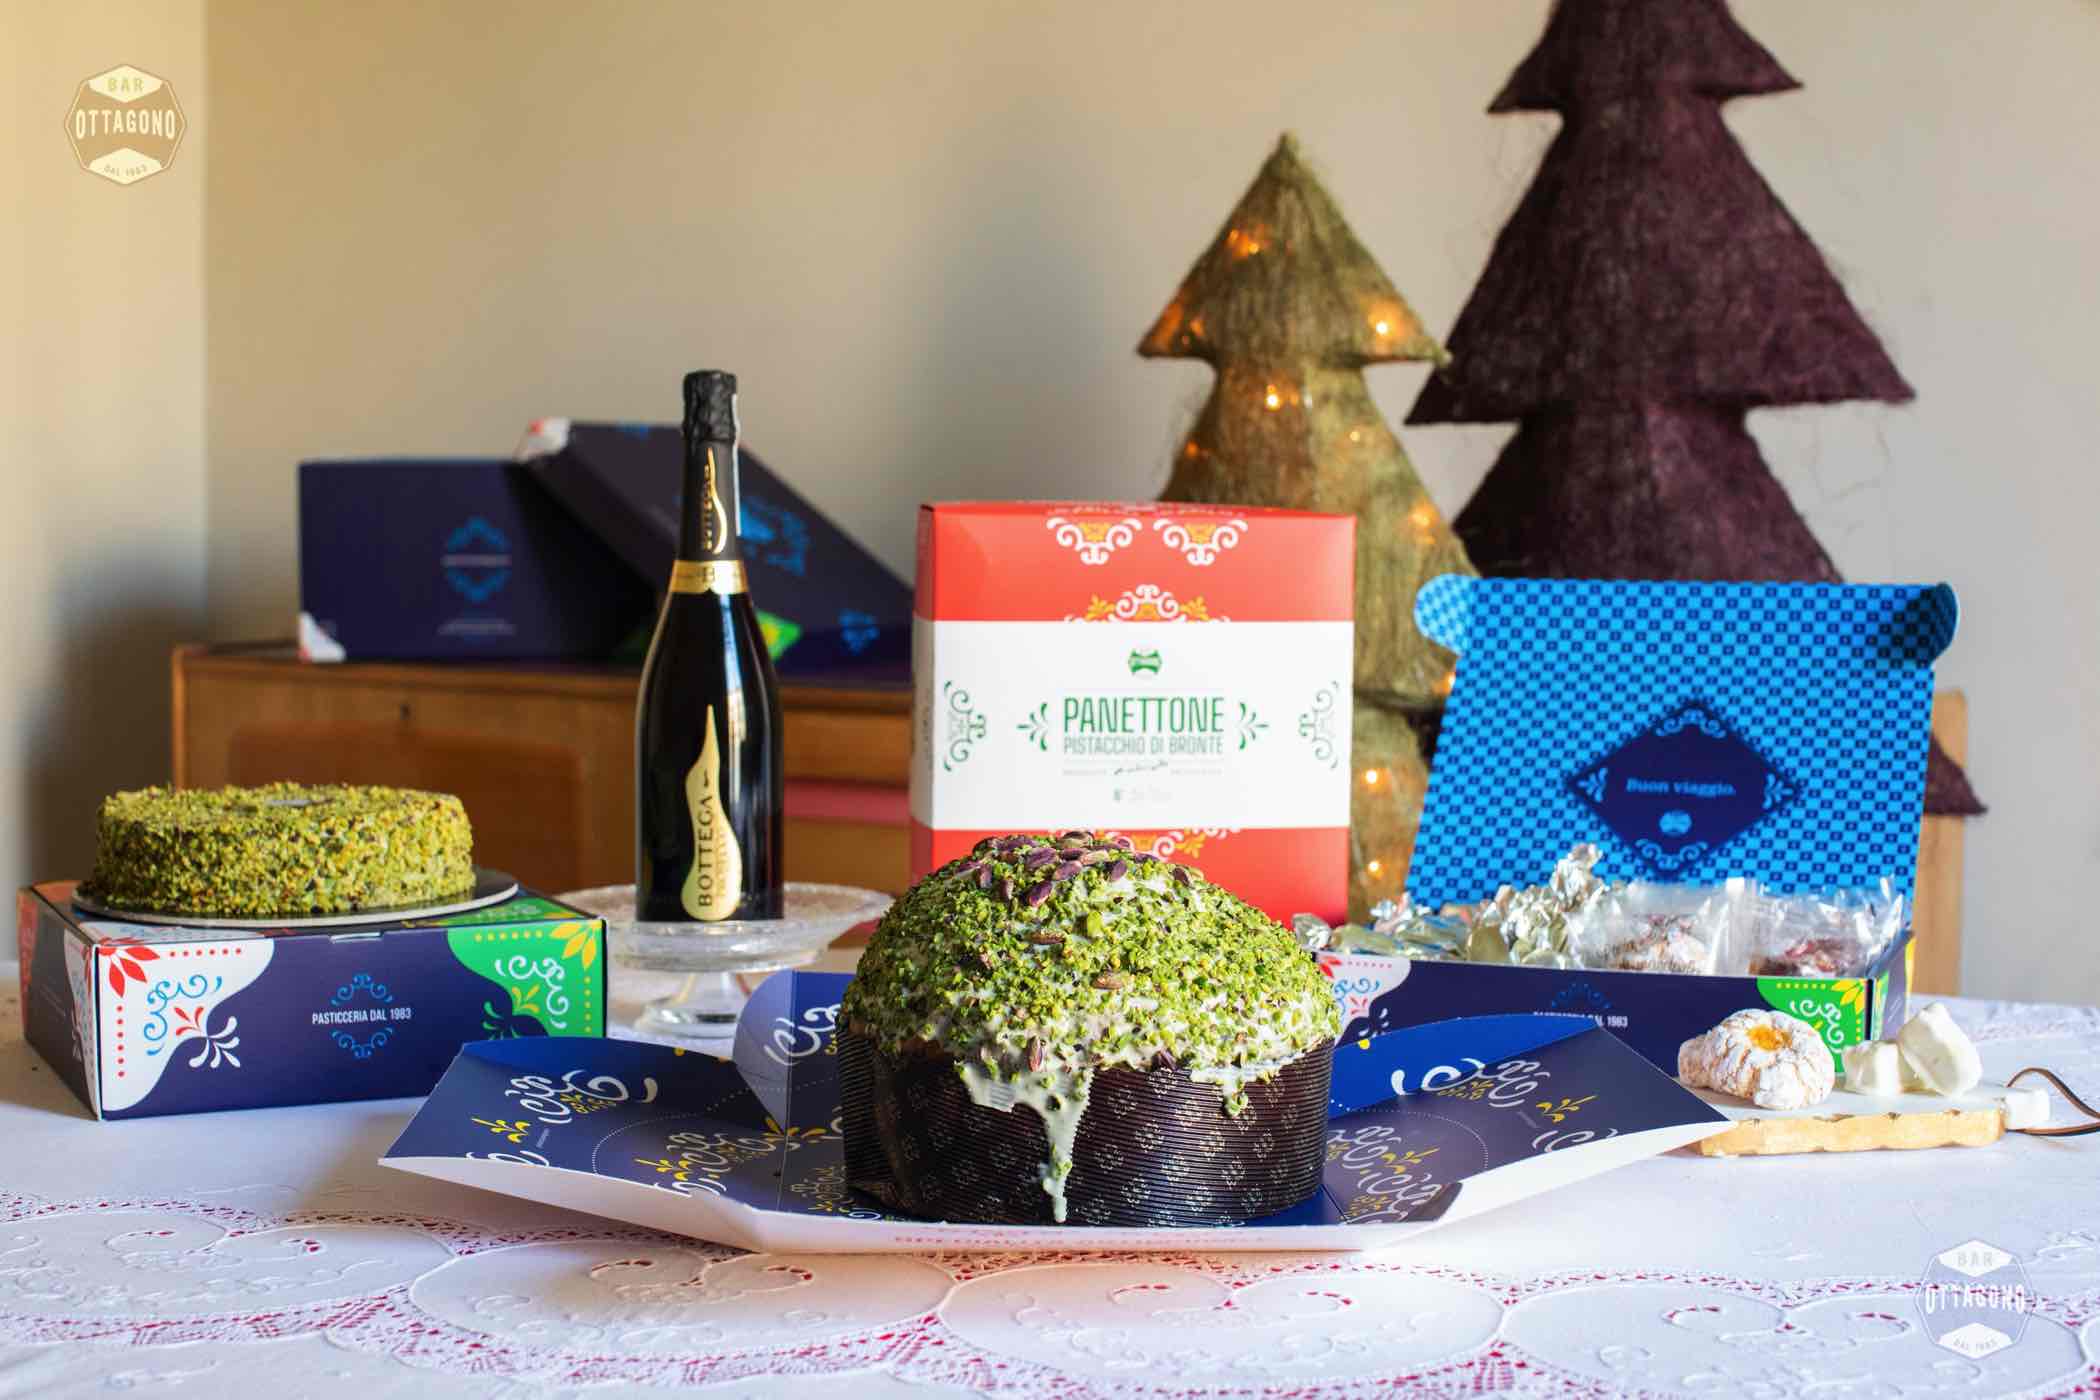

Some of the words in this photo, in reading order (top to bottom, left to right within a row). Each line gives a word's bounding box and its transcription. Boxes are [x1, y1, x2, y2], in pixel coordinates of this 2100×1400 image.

[1063, 697, 1225, 733] PANETTONE
[1063, 736, 1146, 755] PISTACCHIO
[1150, 736, 1165, 755] DI
[1169, 736, 1224, 755] BRONTE
[698, 795, 713, 907] BOTTEGA
[312, 1010, 368, 1025] PASTICCERIA
[370, 1008, 387, 1022] DAL
[390, 1007, 412, 1020] 1983
